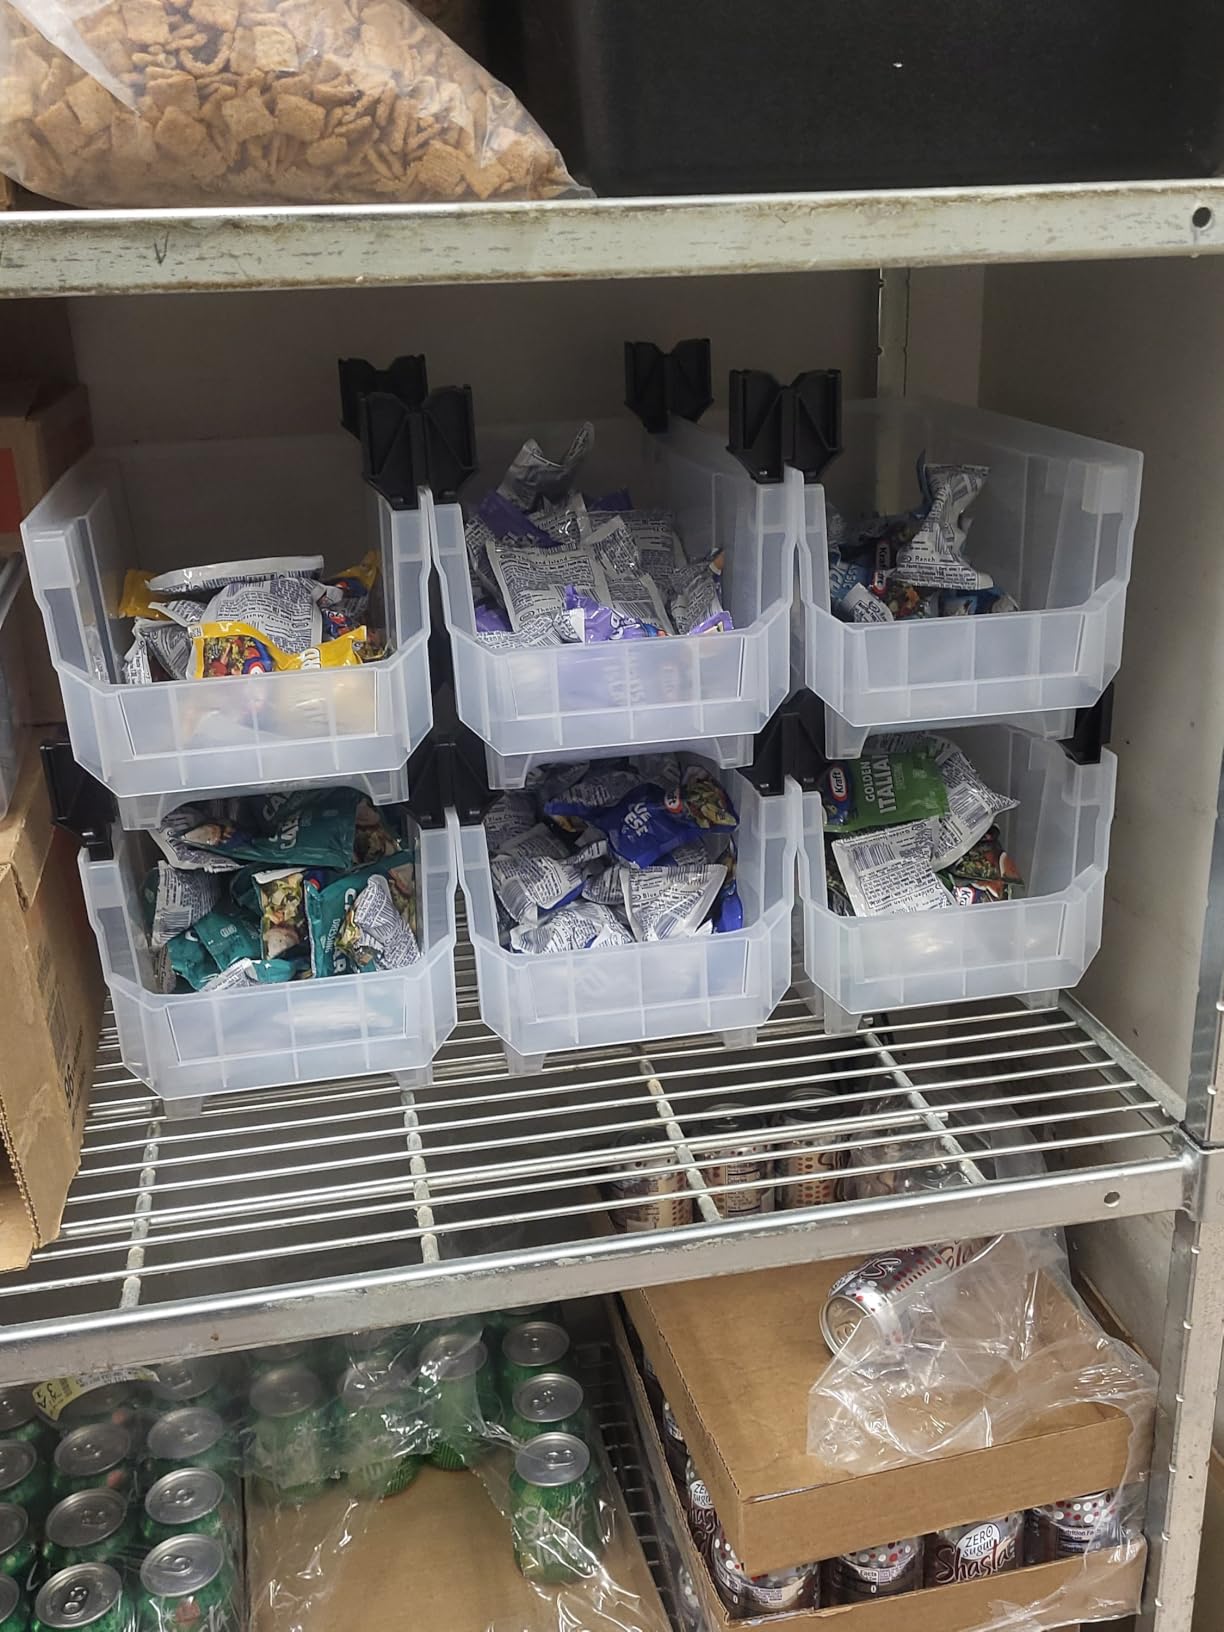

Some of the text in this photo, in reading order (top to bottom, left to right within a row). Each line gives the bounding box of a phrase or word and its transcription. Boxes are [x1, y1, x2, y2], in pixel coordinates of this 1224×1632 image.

[833, 771, 844, 794] Kraft
[860, 761, 876, 802] GOLDEN
[959, 889, 971, 906] Kra
[692, 1494, 711, 1506] suga
[962, 1537, 995, 1557] sugar
[965, 1525, 994, 1548] ZERO
[935, 1538, 1009, 1584] Shasta
